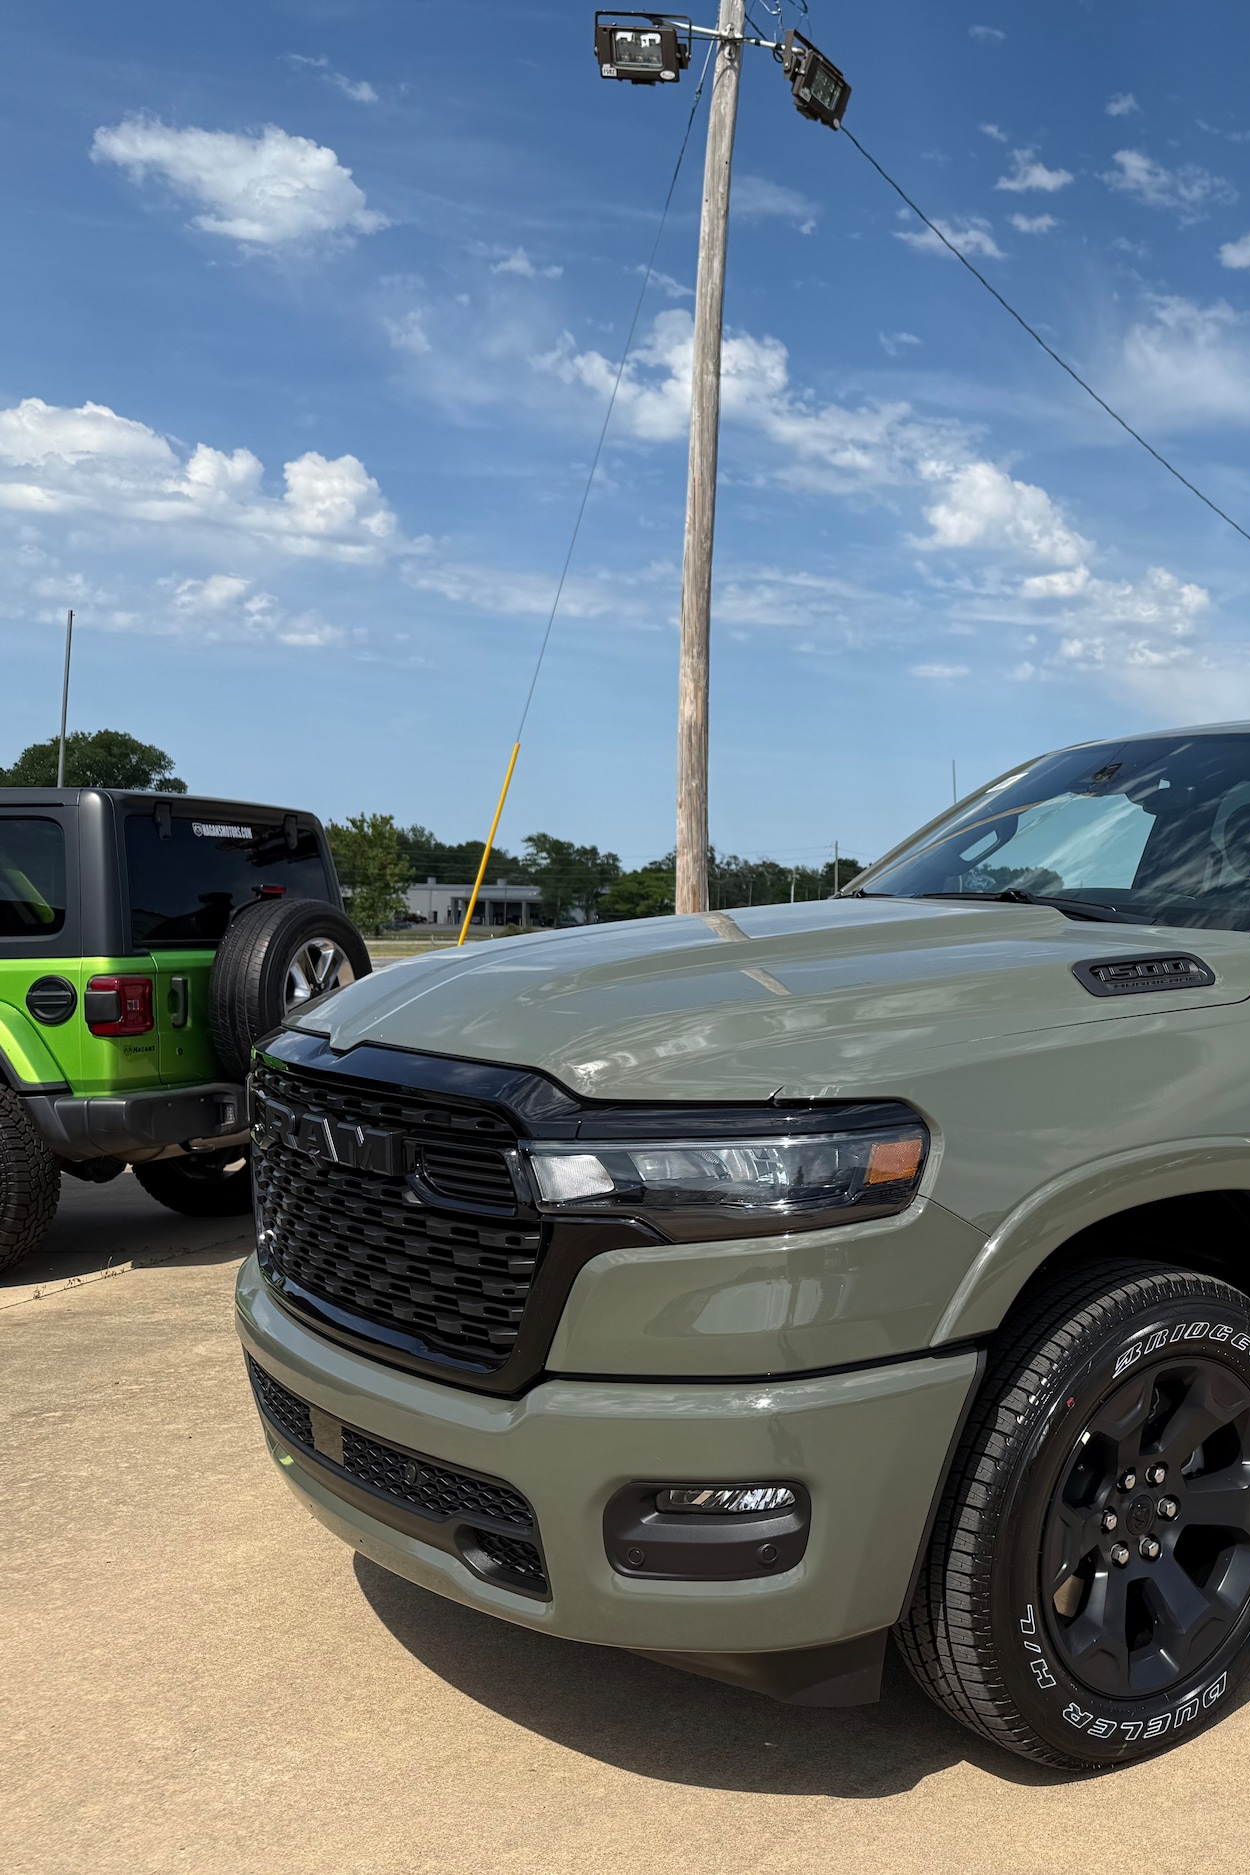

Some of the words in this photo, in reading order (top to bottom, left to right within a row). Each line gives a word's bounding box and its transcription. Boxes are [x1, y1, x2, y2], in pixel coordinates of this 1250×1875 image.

[1092, 959, 1191, 982] 1500
[265, 1099, 398, 1176] RAM
[1020, 1604, 1057, 1689] H/L
[1062, 1671, 1228, 1741] DUELER
